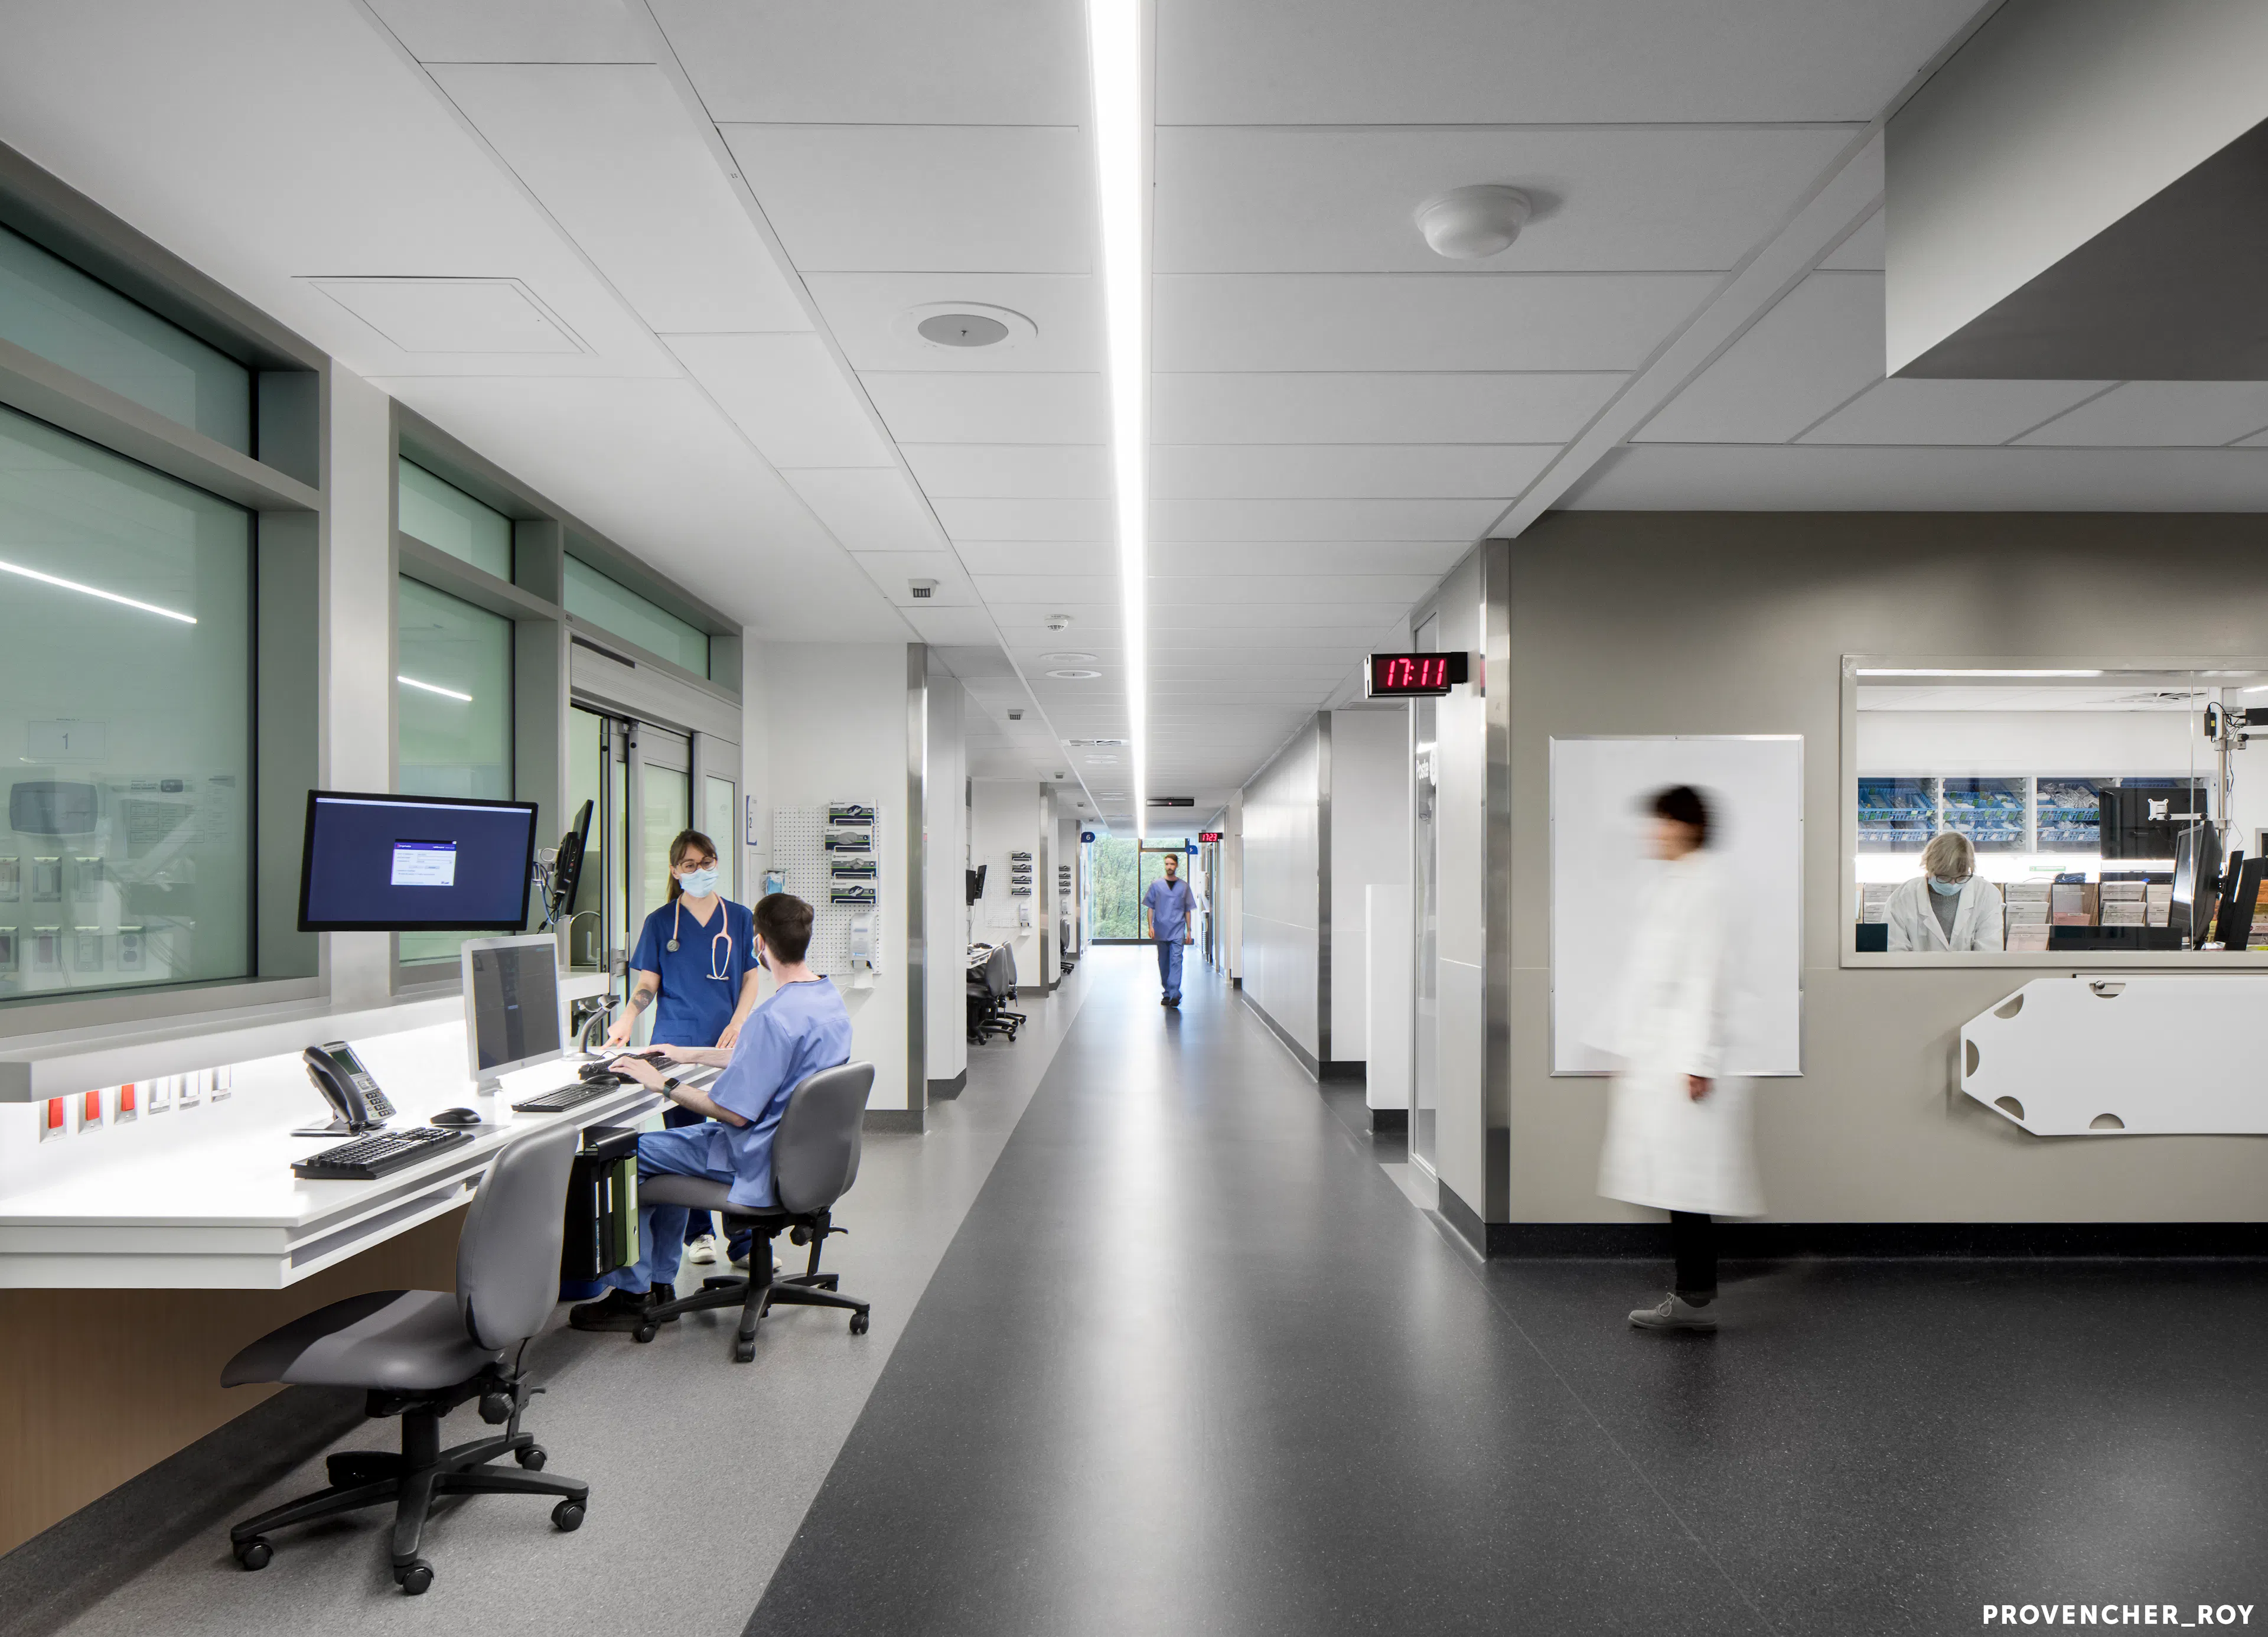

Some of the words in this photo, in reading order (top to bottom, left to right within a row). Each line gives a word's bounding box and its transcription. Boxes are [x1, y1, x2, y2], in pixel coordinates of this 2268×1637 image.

[1387, 658, 1445, 686] 17:11
[61, 733, 69, 750] 1
[749, 817, 753, 828] 2
